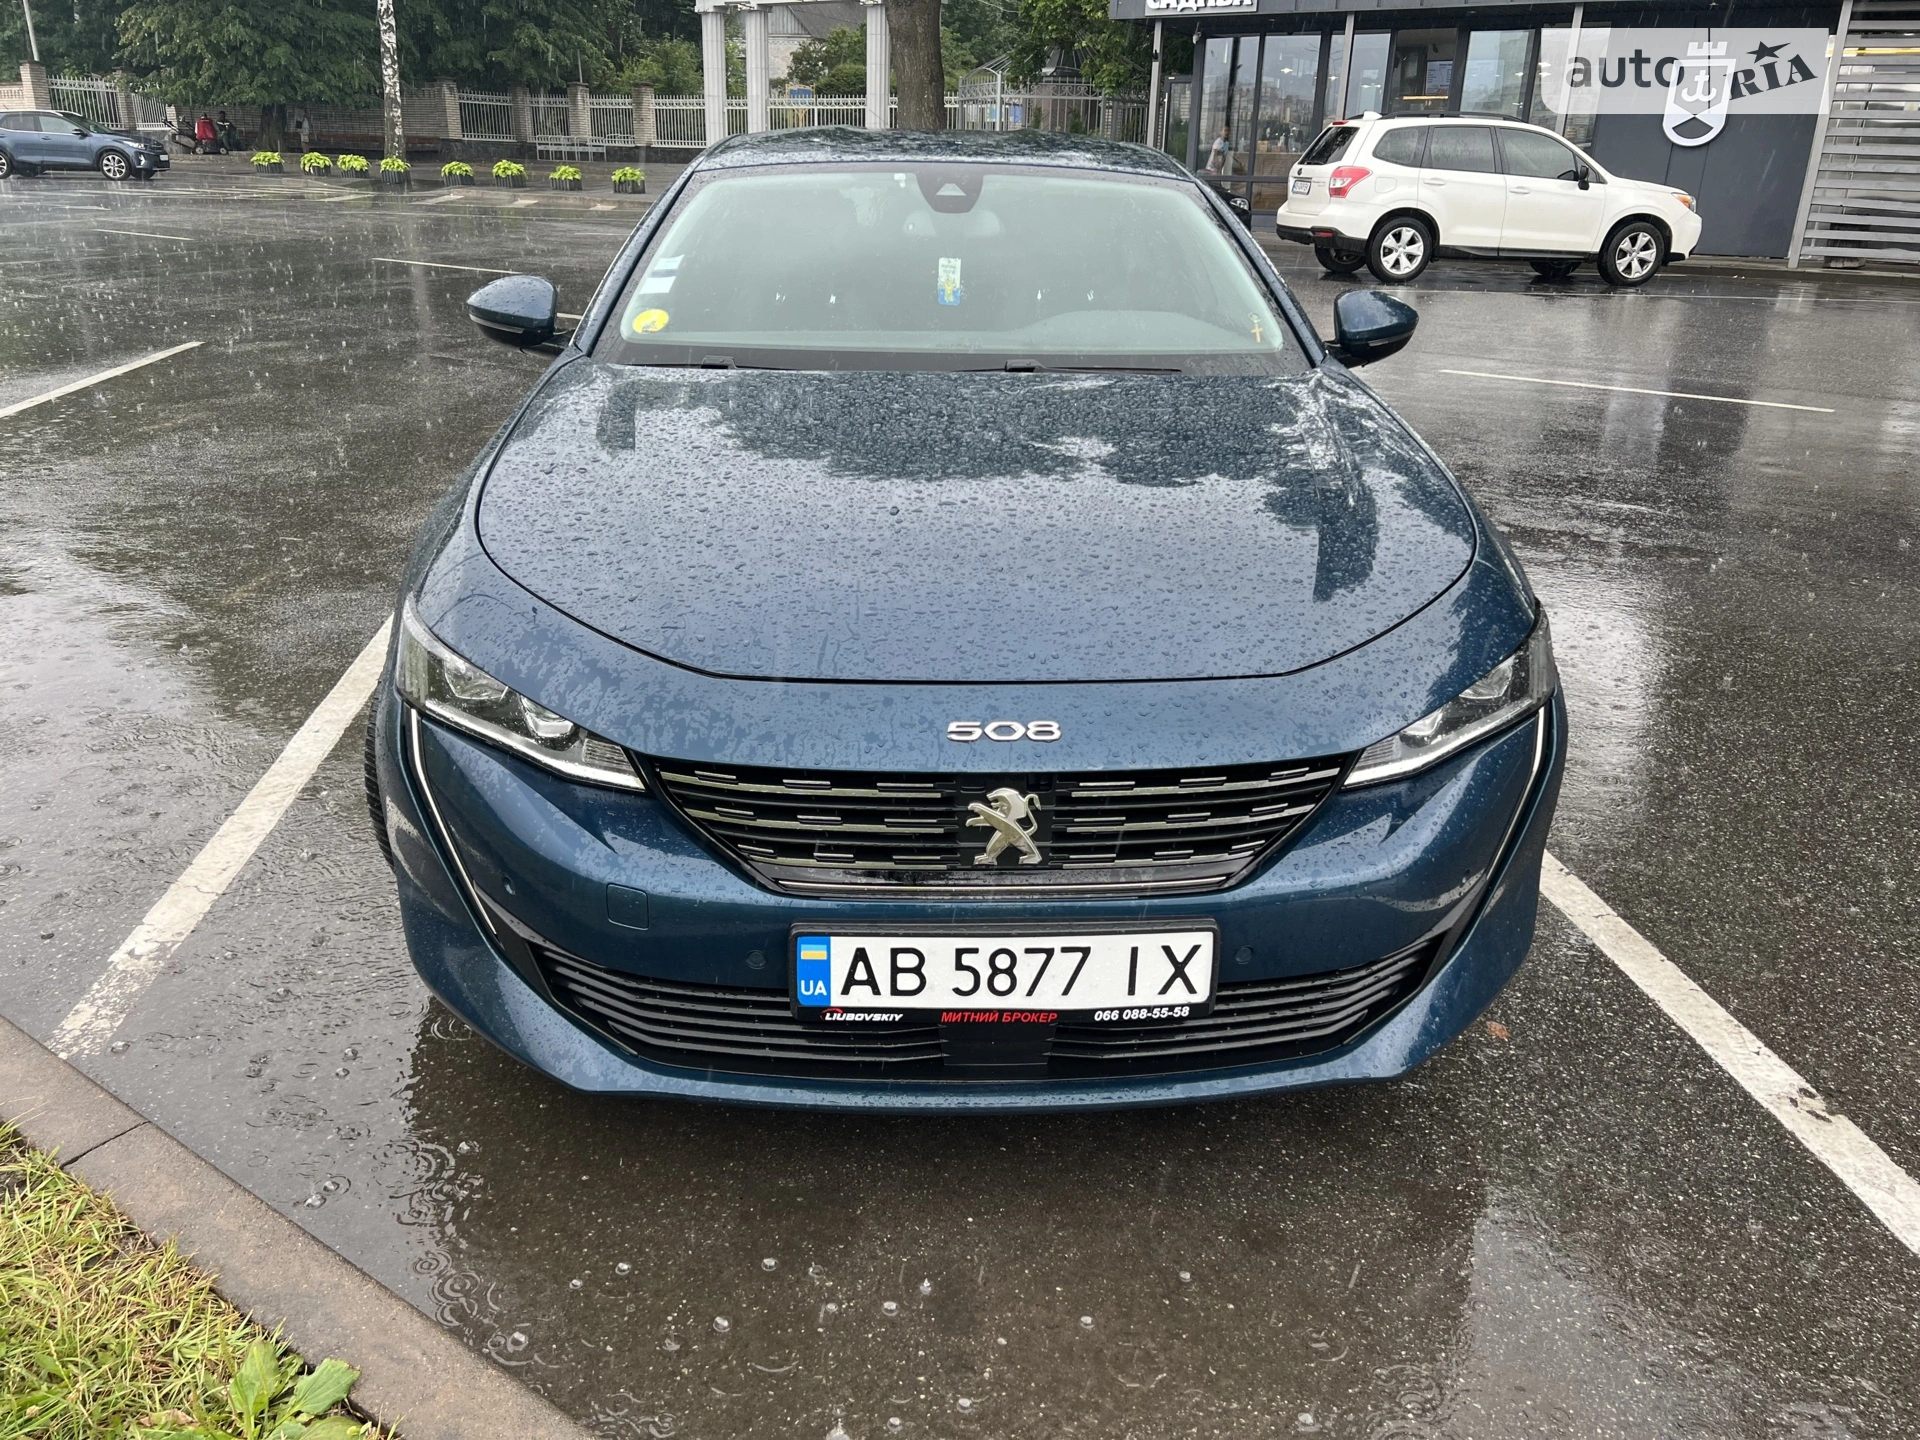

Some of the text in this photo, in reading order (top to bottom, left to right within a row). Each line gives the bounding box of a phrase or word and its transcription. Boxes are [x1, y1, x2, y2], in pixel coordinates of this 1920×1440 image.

[947, 721, 1061, 742] 508
[840, 944, 1202, 997] AB 5877 IX
[801, 979, 827, 996] UA
[824, 1012, 903, 1022] LIUBOVSKIY
[941, 1010, 1058, 1023] МИТНИЙ БРОКЕР
[1094, 1006, 1190, 1021] 066 088-55-58
